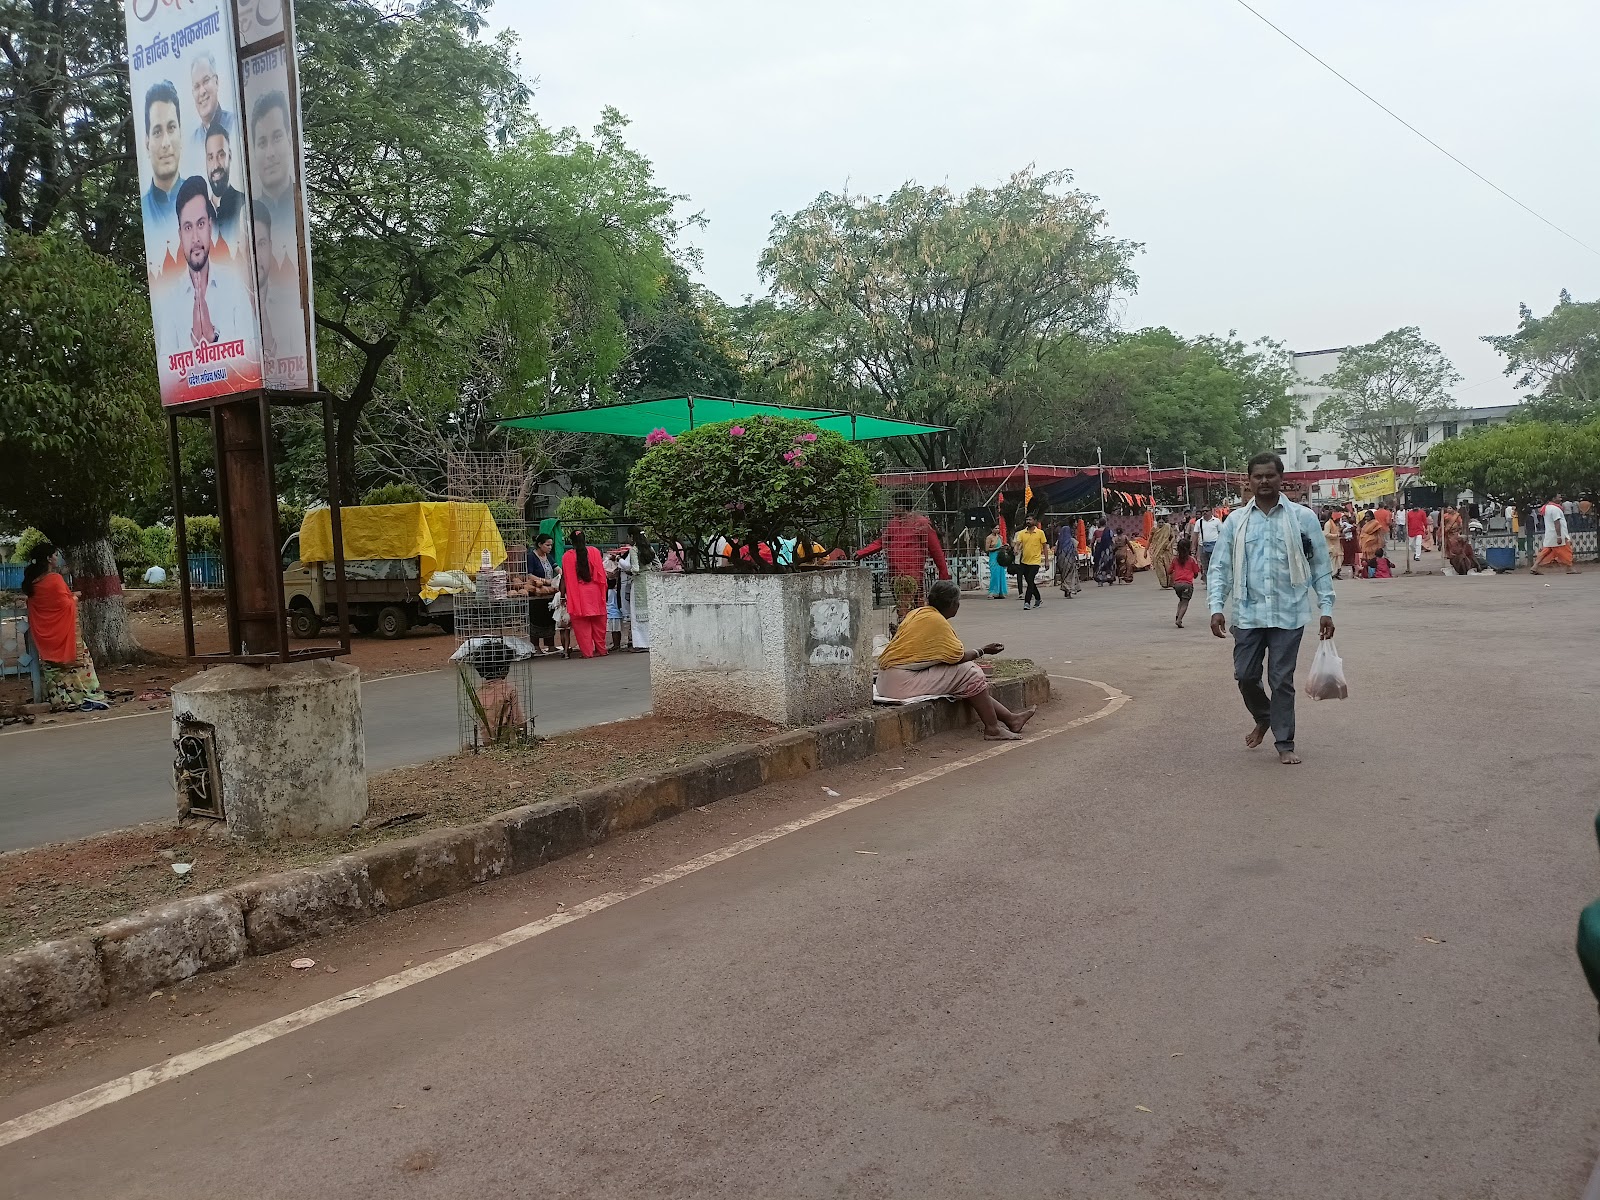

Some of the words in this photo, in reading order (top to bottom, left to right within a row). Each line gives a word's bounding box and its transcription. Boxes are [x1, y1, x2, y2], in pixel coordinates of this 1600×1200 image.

[132, 44, 145, 71] की
[145, 32, 170, 66] हार्दिक
[169, 350, 194, 377] अतुल
[195, 339, 245, 364] श्रीवास्तव
